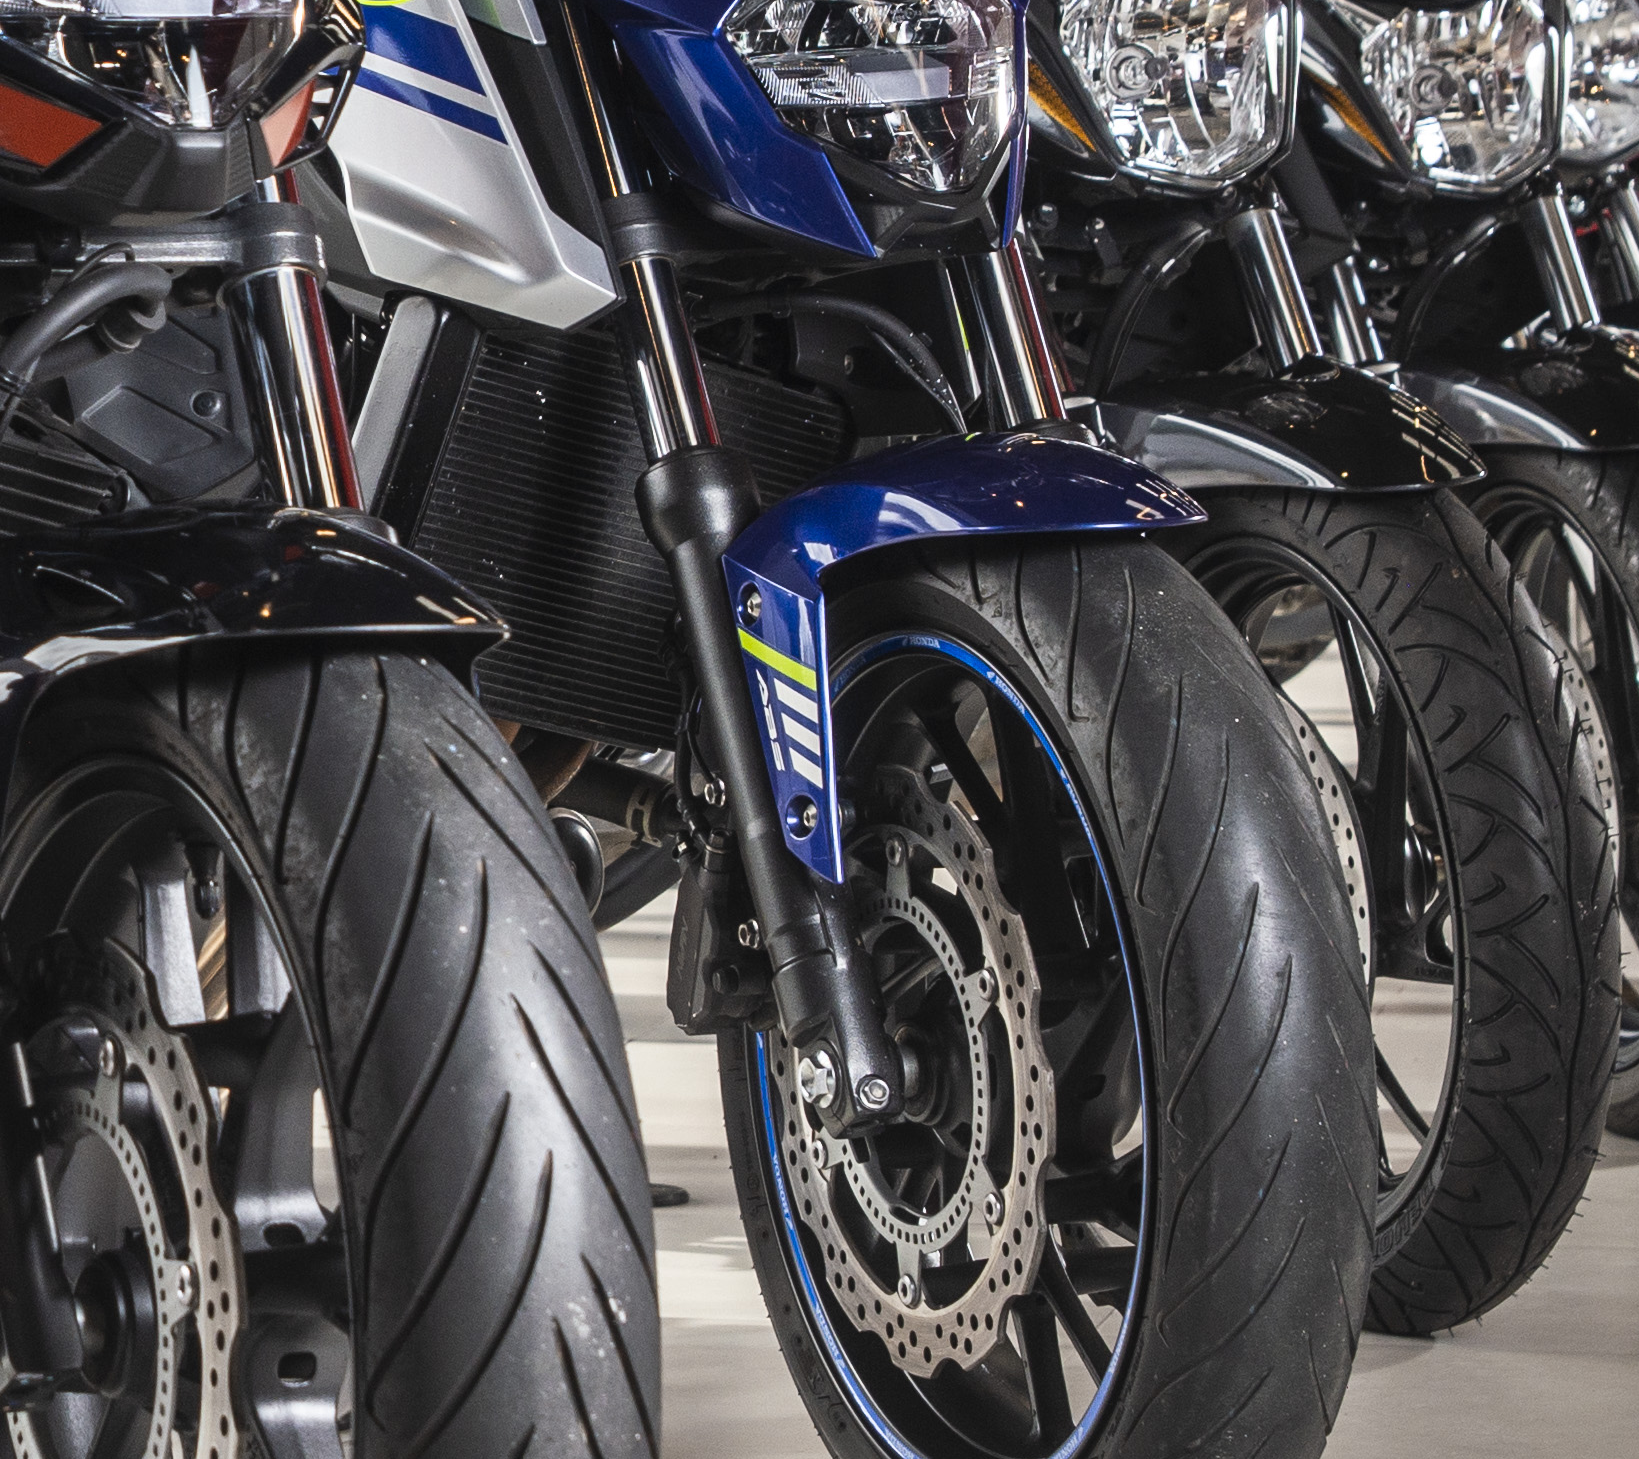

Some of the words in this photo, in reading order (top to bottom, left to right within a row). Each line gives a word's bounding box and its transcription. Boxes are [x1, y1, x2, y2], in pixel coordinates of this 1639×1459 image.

[908, 636, 941, 649] HONDA
[755, 668, 787, 772] ABS
[994, 676, 1026, 715] HONDA
[773, 1153, 791, 1219] HONDA
